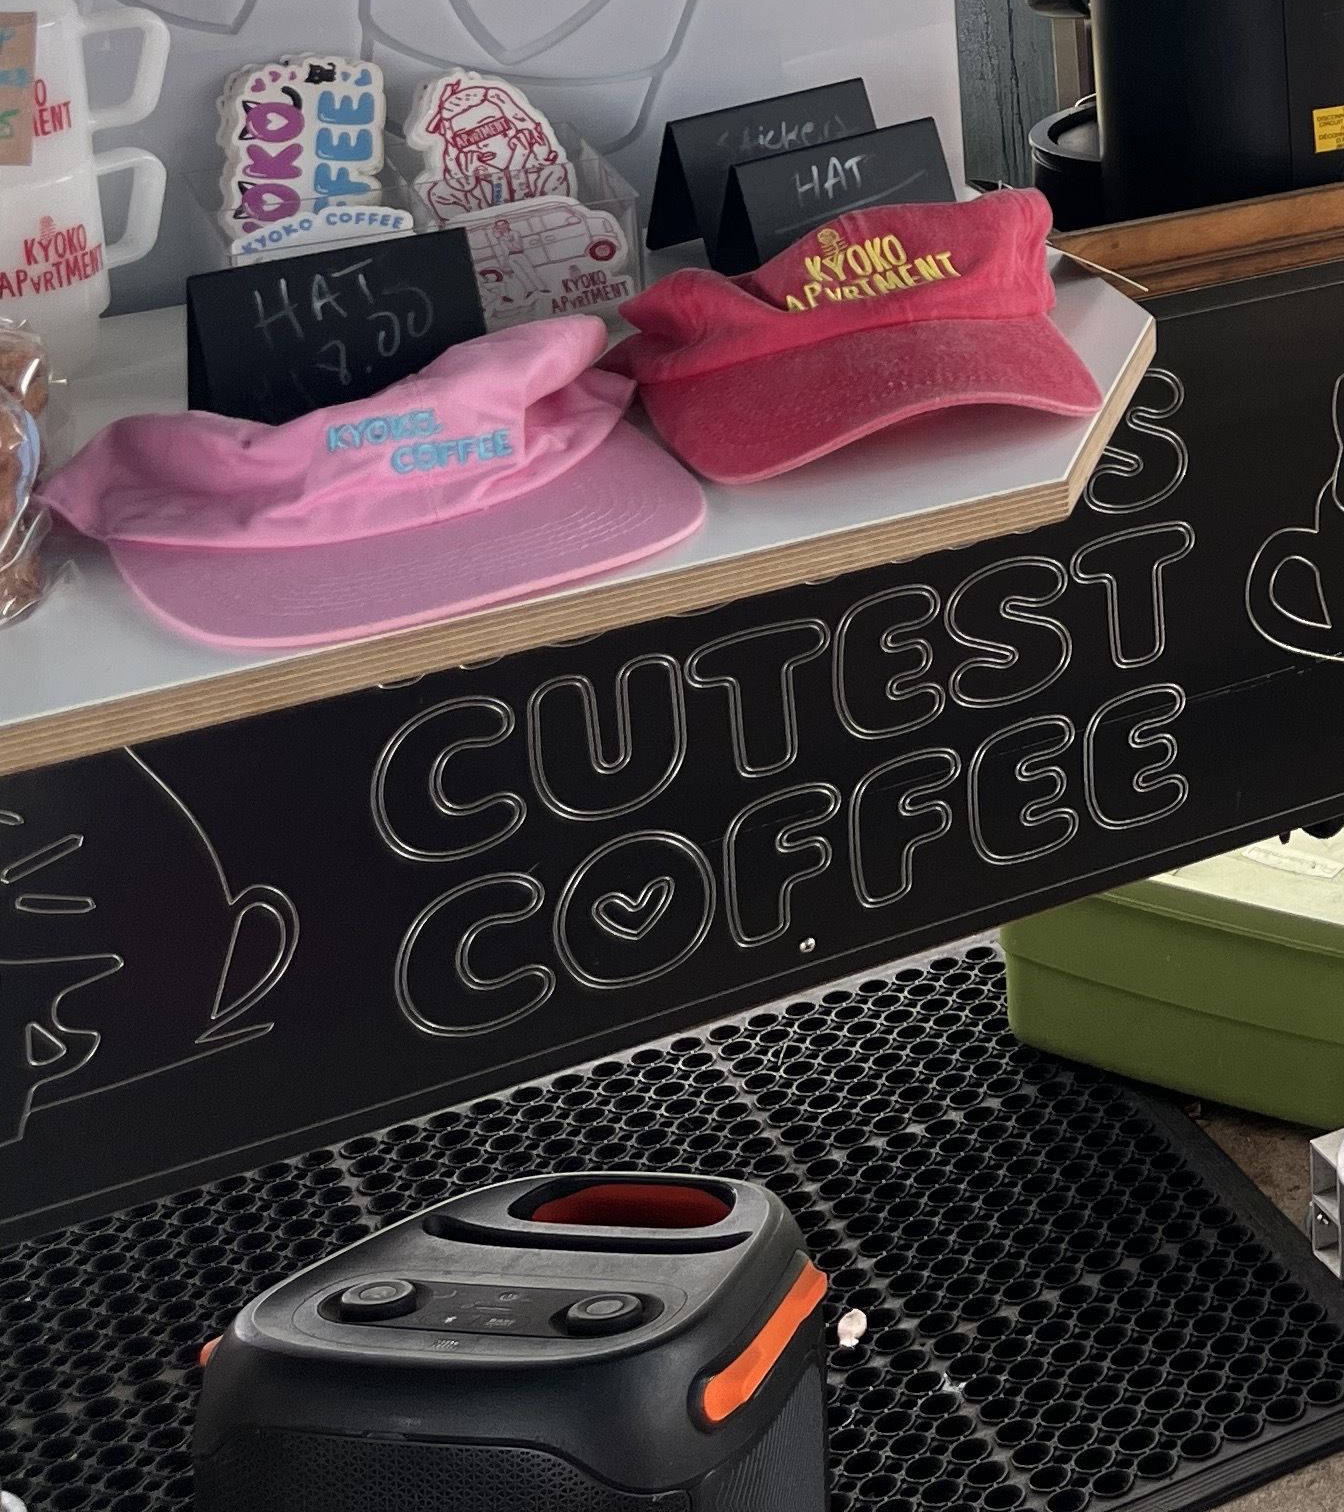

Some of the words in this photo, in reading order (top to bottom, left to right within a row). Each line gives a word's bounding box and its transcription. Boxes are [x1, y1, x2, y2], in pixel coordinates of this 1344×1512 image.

[241, 100, 306, 235] OKO
[313, 89, 376, 215] FEE
[795, 152, 867, 200] HAT
[23, 223, 88, 266] KYOKO
[239, 217, 315, 257] KYOKO
[325, 210, 407, 229] COFFEE
[803, 232, 909, 286] KYOKO
[254, 258, 376, 350] HAT
[560, 268, 608, 293] KYOKO
[326, 407, 444, 454] KYOKO
[390, 428, 513, 476] COFFEE
[371, 520, 1197, 862] CUTEST
[394, 682, 1190, 1038] COFFEE
